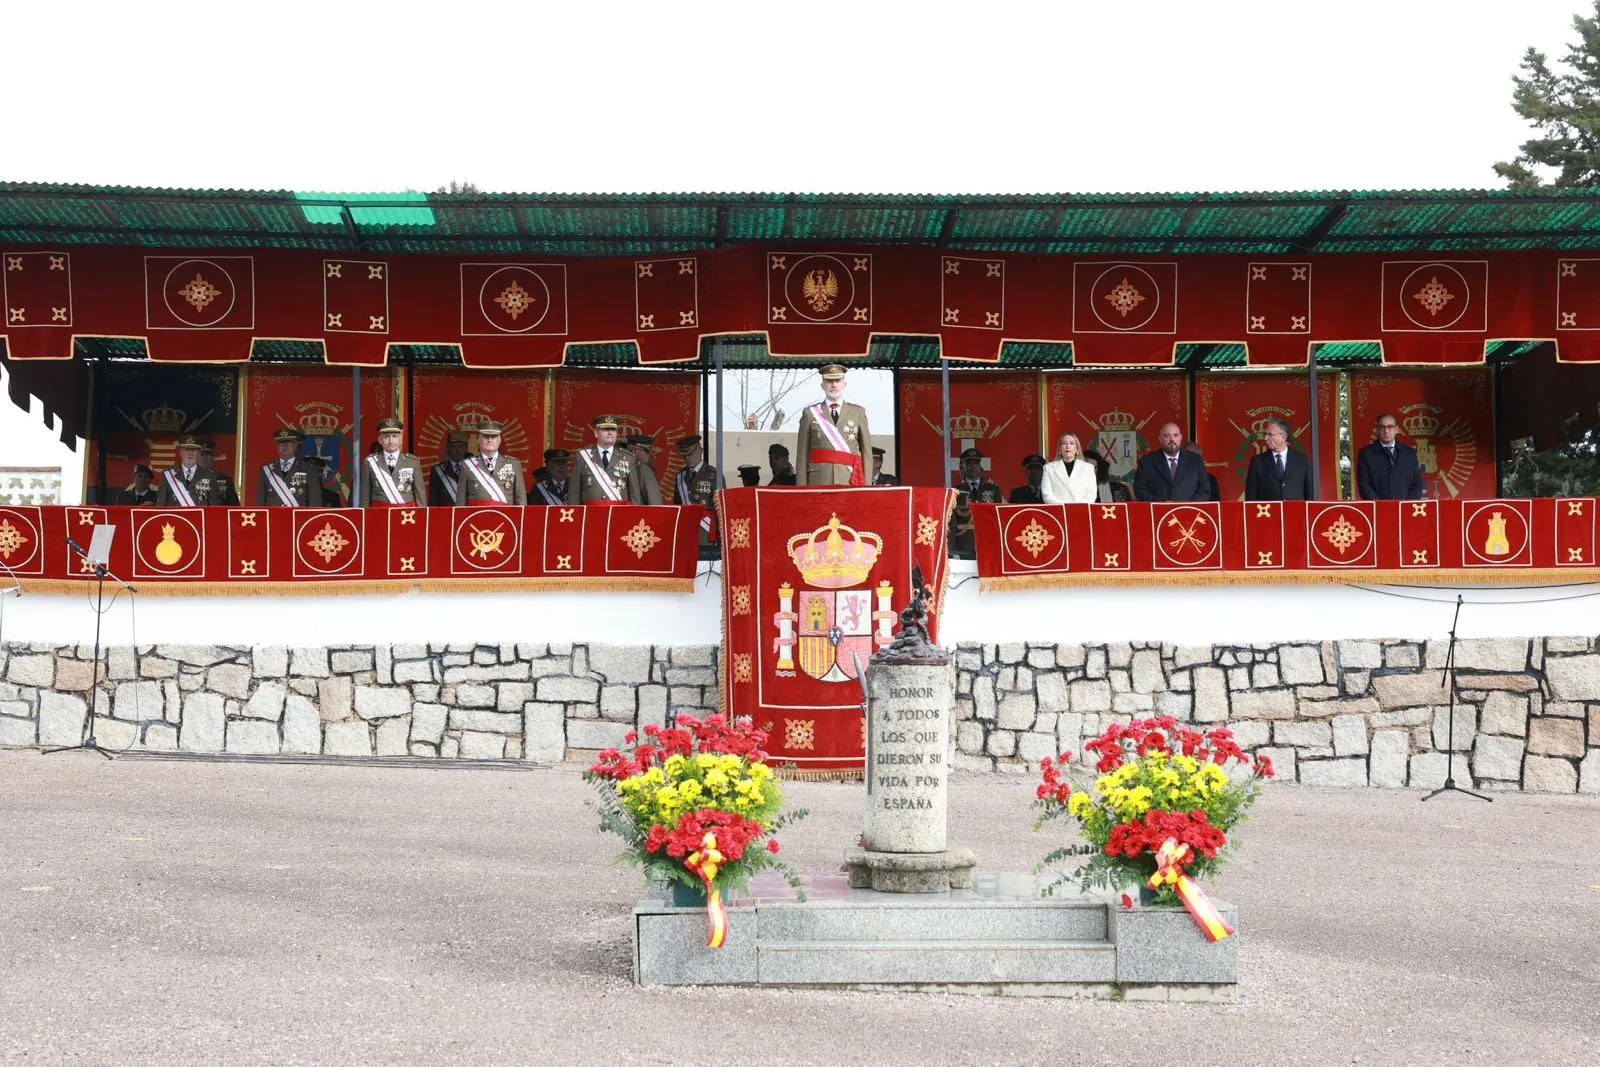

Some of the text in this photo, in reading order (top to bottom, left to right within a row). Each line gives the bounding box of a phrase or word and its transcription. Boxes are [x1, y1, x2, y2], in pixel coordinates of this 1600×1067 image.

[889, 687, 934, 699] HONOR
[896, 709, 940, 721] TODOS
[881, 731, 939, 744] LOS QUE
[876, 753, 942, 765] DIERON SU
[878, 776, 939, 788] VIDA POR
[883, 796, 933, 810] ESPAÑA
